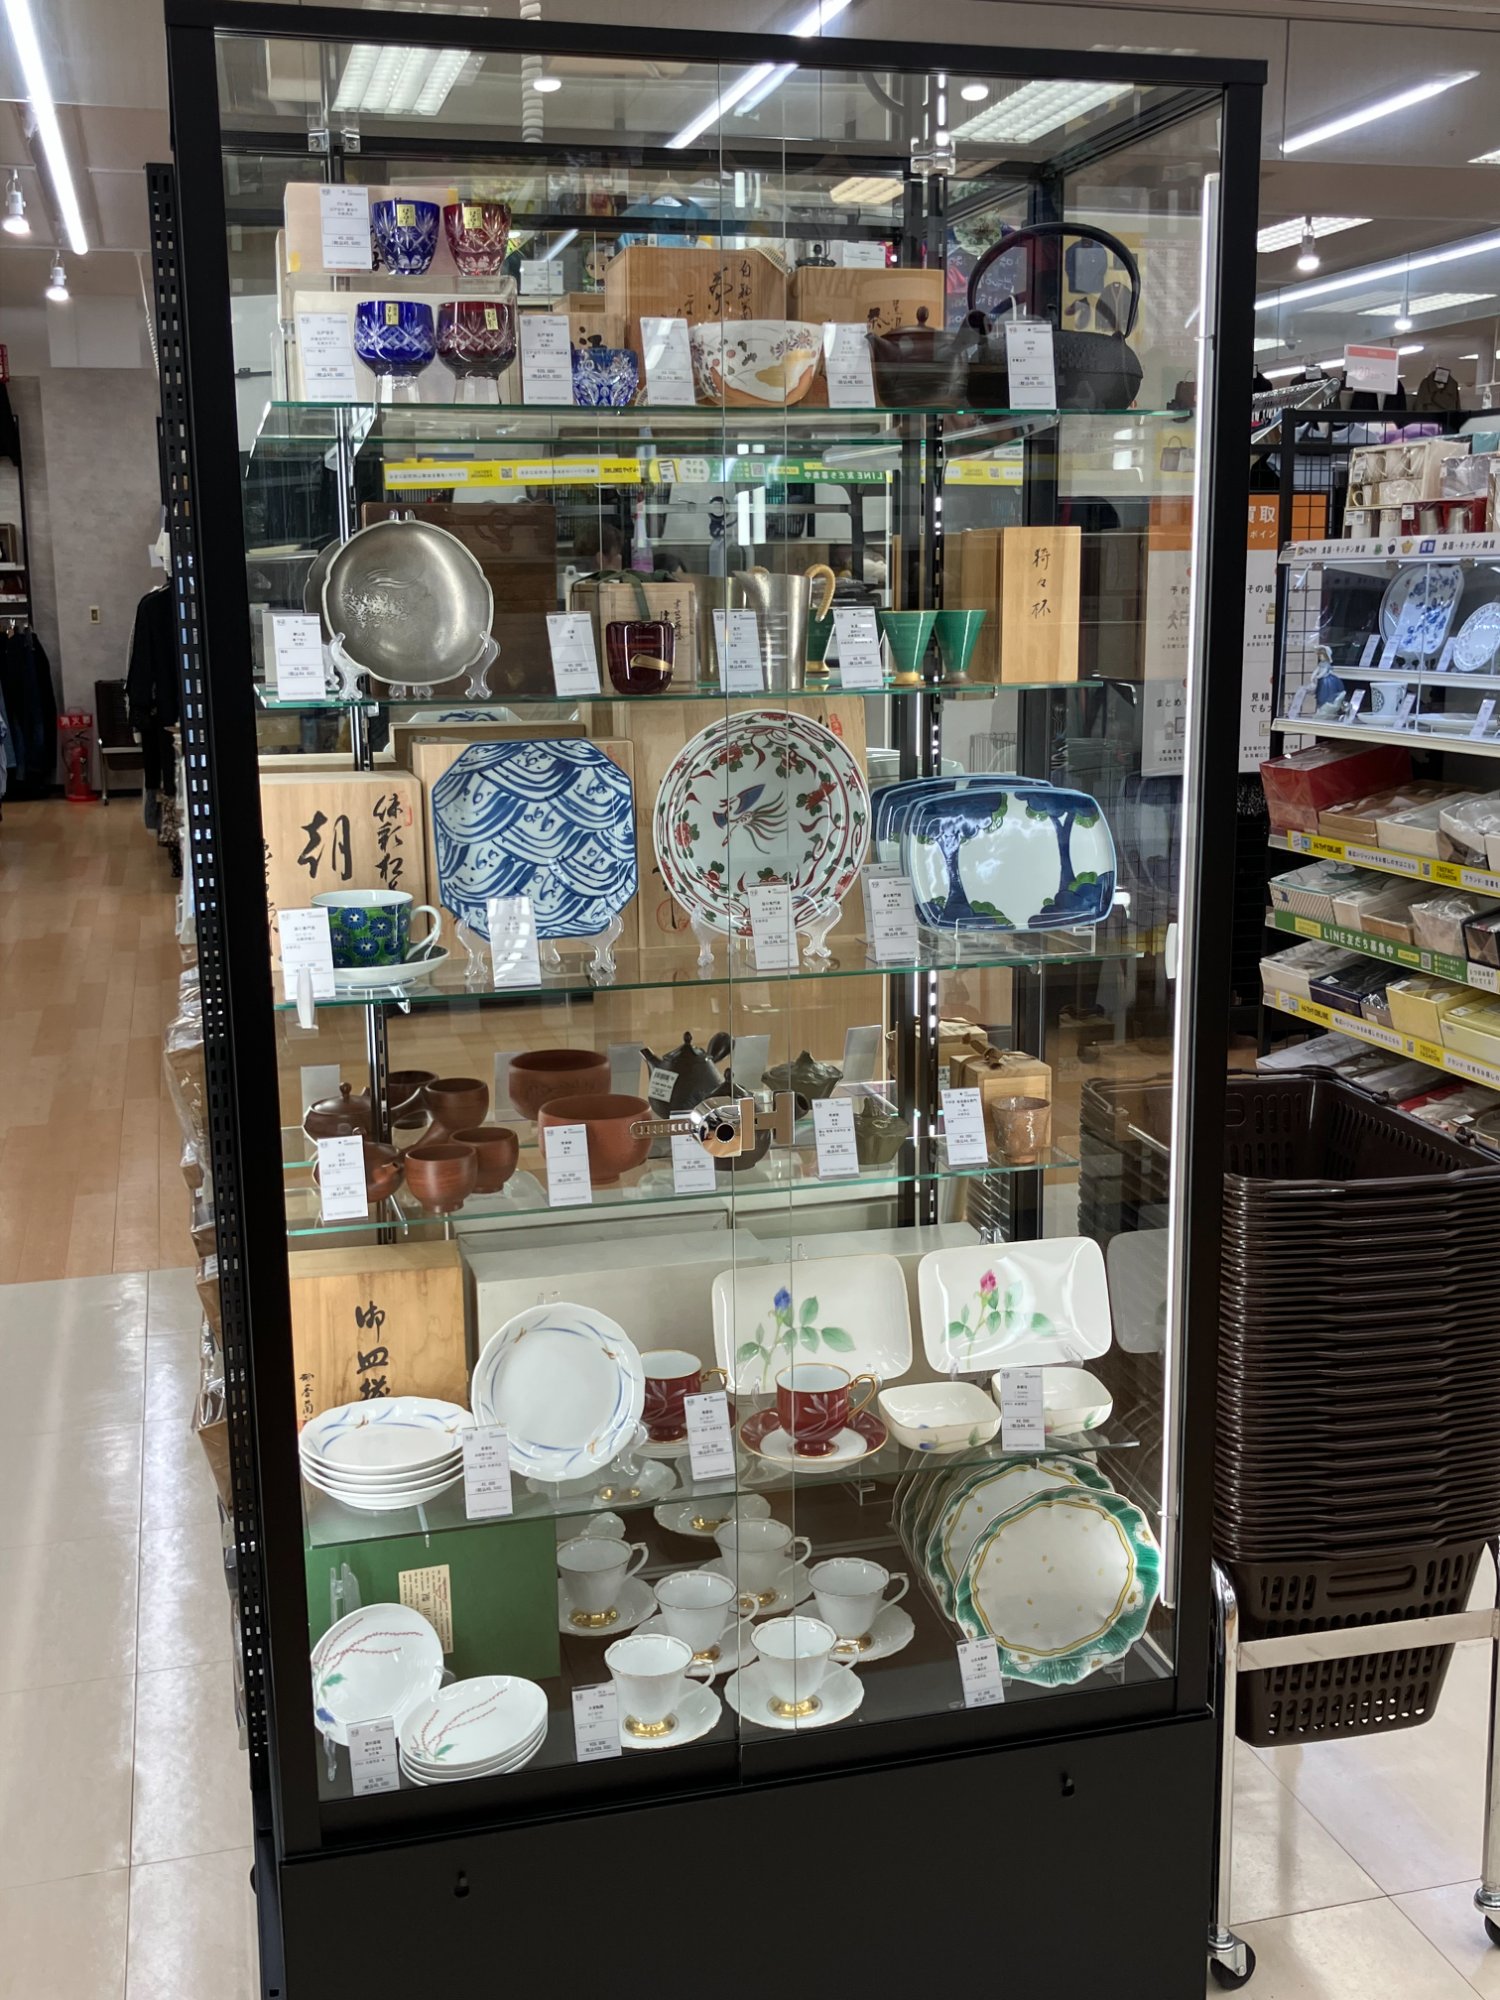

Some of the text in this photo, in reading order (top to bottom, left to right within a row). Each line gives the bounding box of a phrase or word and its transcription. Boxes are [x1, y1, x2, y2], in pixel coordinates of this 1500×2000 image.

[1442, 539, 1496, 551] 食器・キッチン雑貨
[1247, 584, 1276, 594] その場
[1156, 698, 1186, 708] まとめ
[1323, 927, 1394, 957] LINE友だち募集中
